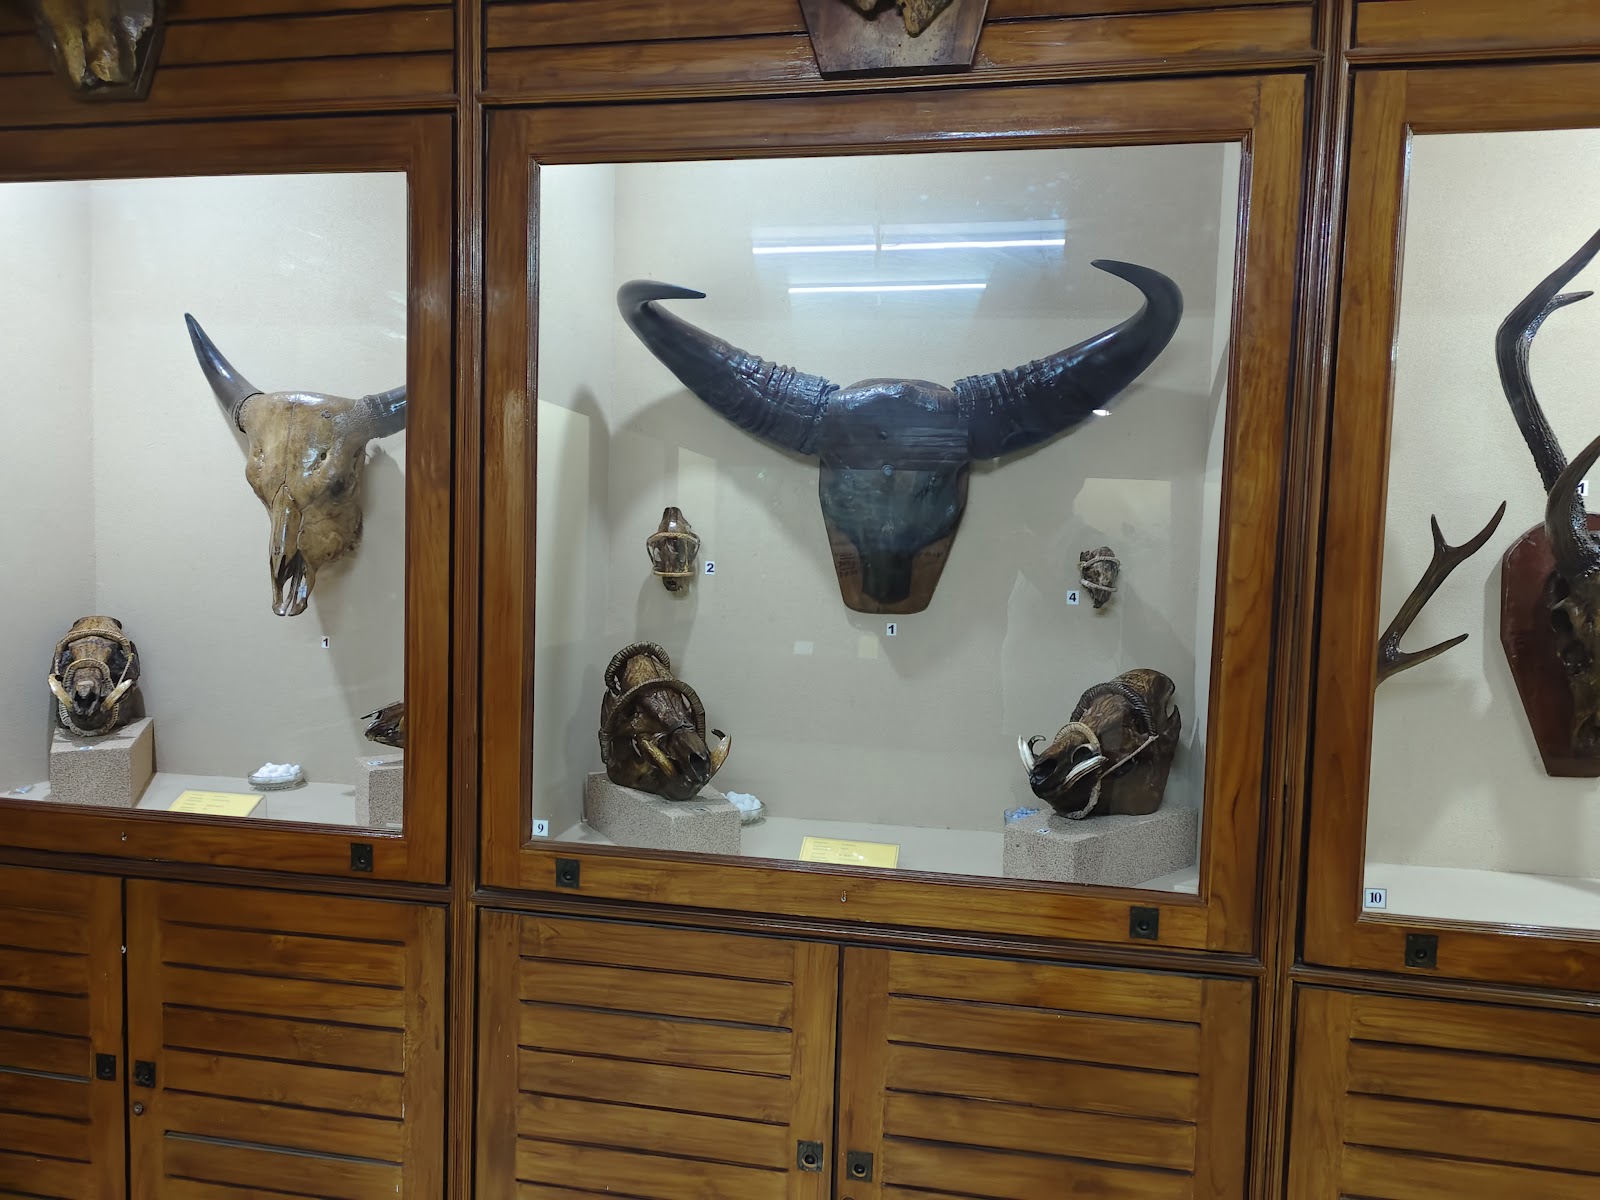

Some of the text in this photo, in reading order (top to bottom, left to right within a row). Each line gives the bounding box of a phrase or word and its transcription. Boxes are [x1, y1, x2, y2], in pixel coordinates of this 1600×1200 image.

[1577, 482, 1584, 494] 1
[706, 562, 714, 573] 2
[1069, 592, 1077, 602] 4
[888, 624, 894, 635] 1
[323, 637, 328, 647] 1
[537, 823, 544, 834] 9
[1369, 891, 1382, 904] 10
